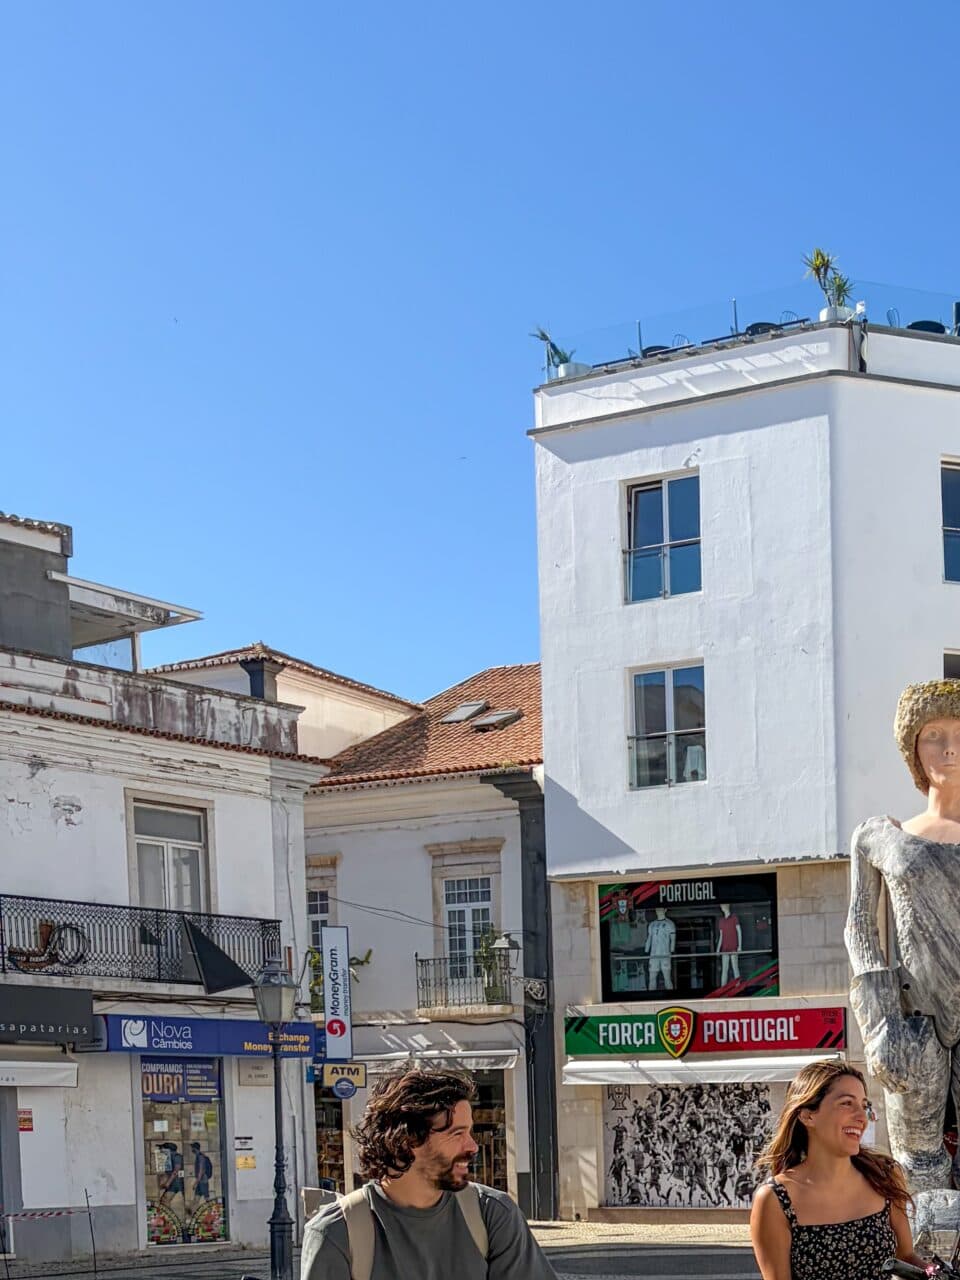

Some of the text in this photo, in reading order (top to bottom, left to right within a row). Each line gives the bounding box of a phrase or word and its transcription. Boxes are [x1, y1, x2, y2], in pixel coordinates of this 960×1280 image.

[659, 881, 717, 902] PORTUGAL
[329, 948, 341, 1016] MoneyGram
[0, 1023, 88, 1034] sapatarias
[151, 1021, 192, 1039] Nova
[599, 1017, 799, 1047] FORÇA PORTUGAL
[151, 1038, 193, 1049] Câmbios
[268, 1033, 310, 1043] Echange
[244, 1042, 273, 1053] Money
[278, 1043, 311, 1053] ransfer
[141, 1063, 183, 1073] COMPRAMOS
[330, 1066, 360, 1077] ATM
[143, 1074, 183, 1095] OURO
